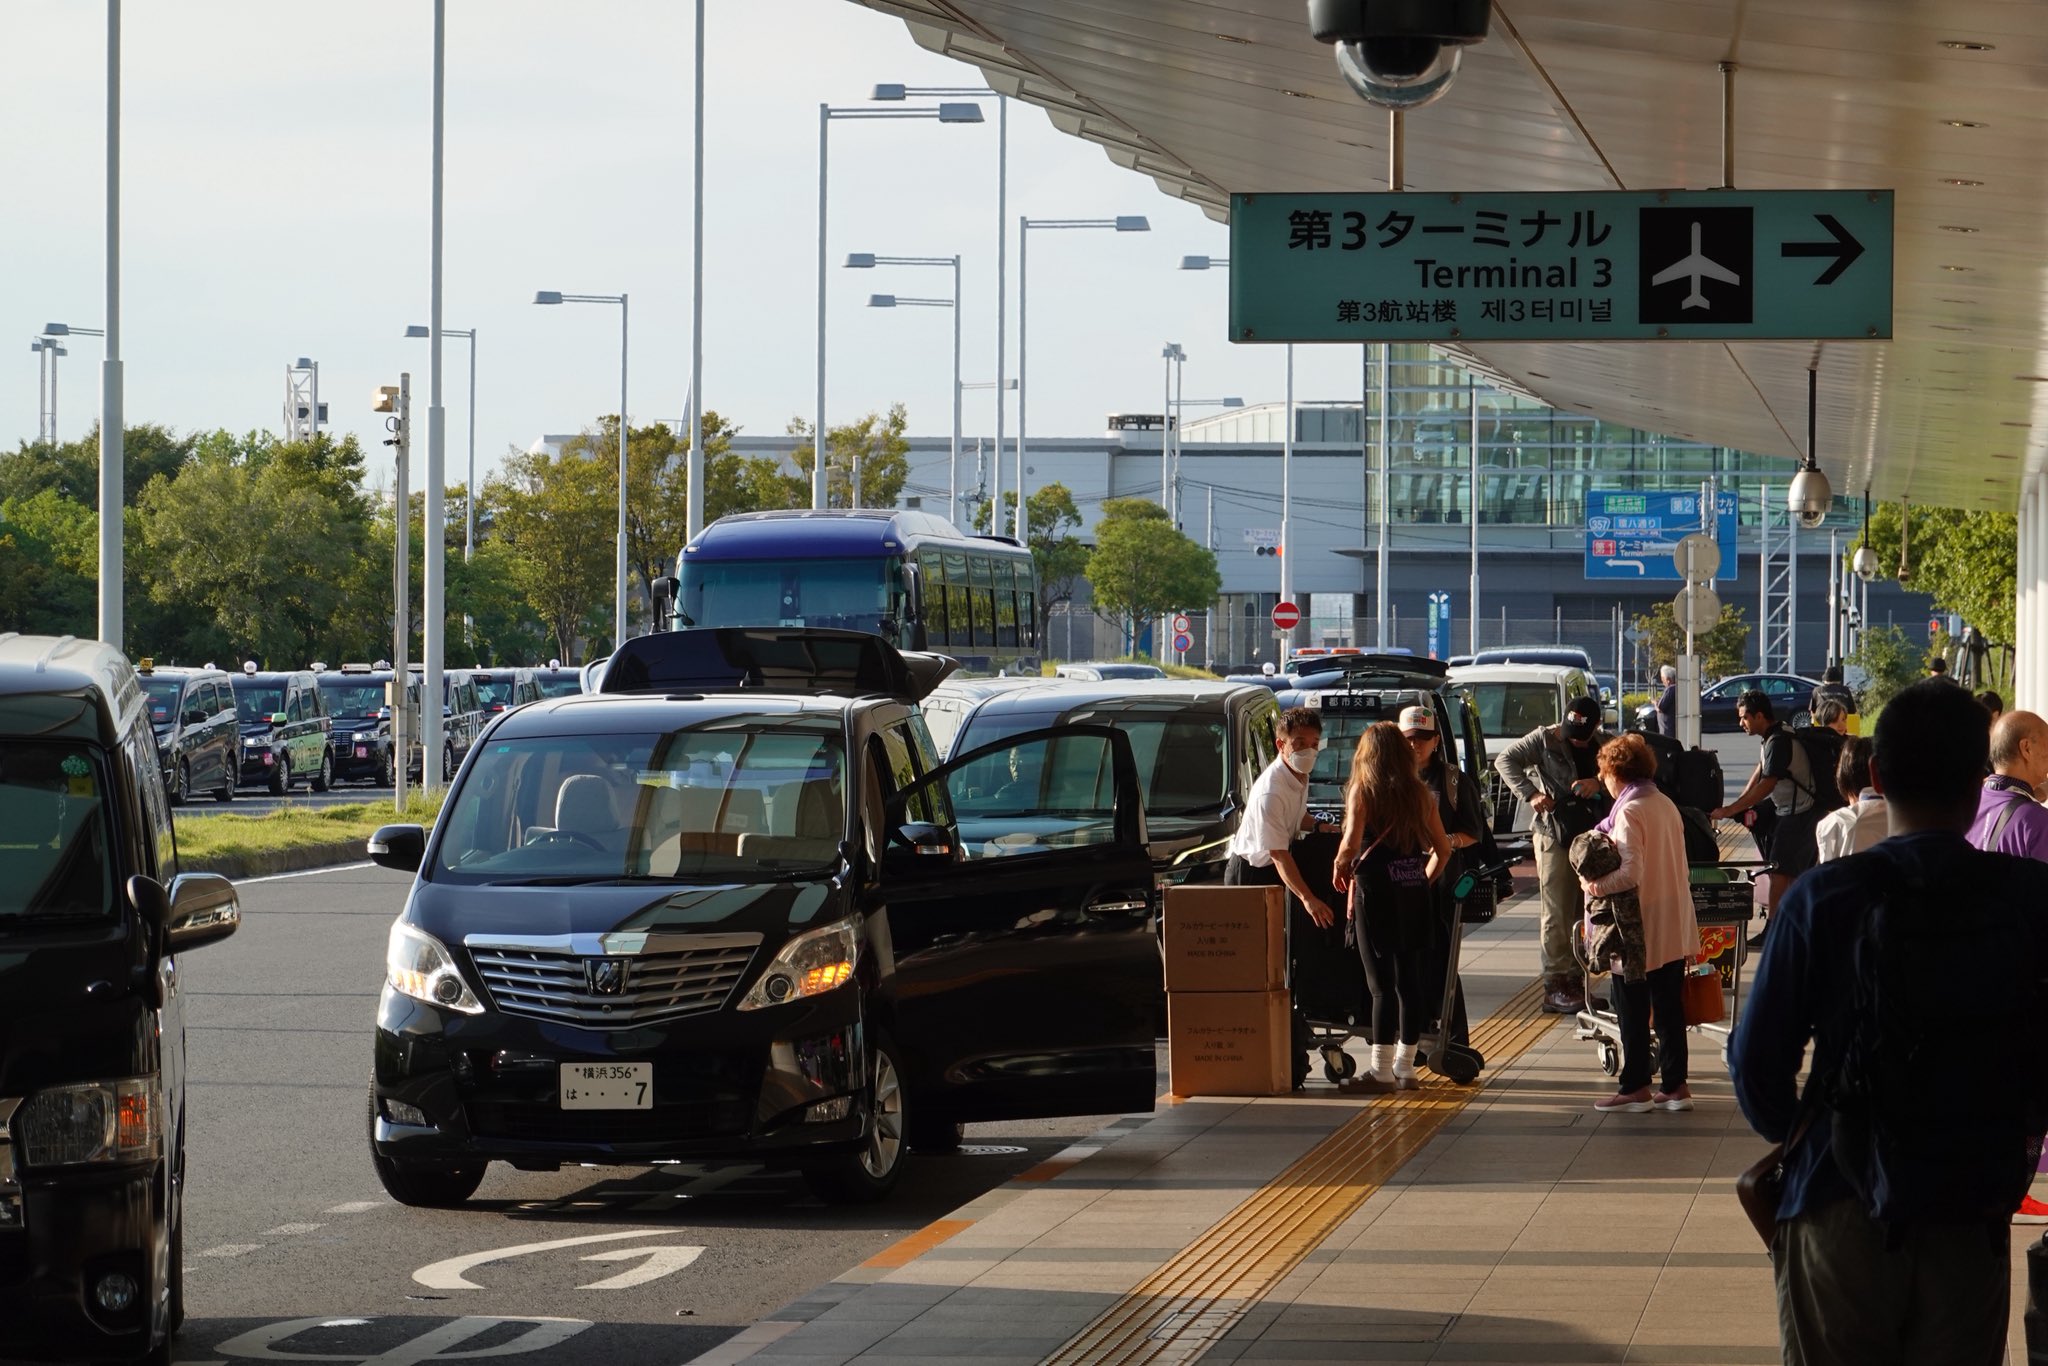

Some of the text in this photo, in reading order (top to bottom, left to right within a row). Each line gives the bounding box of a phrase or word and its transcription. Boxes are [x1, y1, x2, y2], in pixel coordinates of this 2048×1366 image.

[1287, 209, 1612, 251] 第3ターミナル
[1414, 257, 1612, 289] Terminal 3
[1336, 298, 1457, 325] 第3航站楼
[1480, 298, 1612, 325] 제3터미널
[1592, 519, 1608, 530] 357
[1329, 696, 1375, 707] 都市交通
[566, 1088, 578, 1101] は
